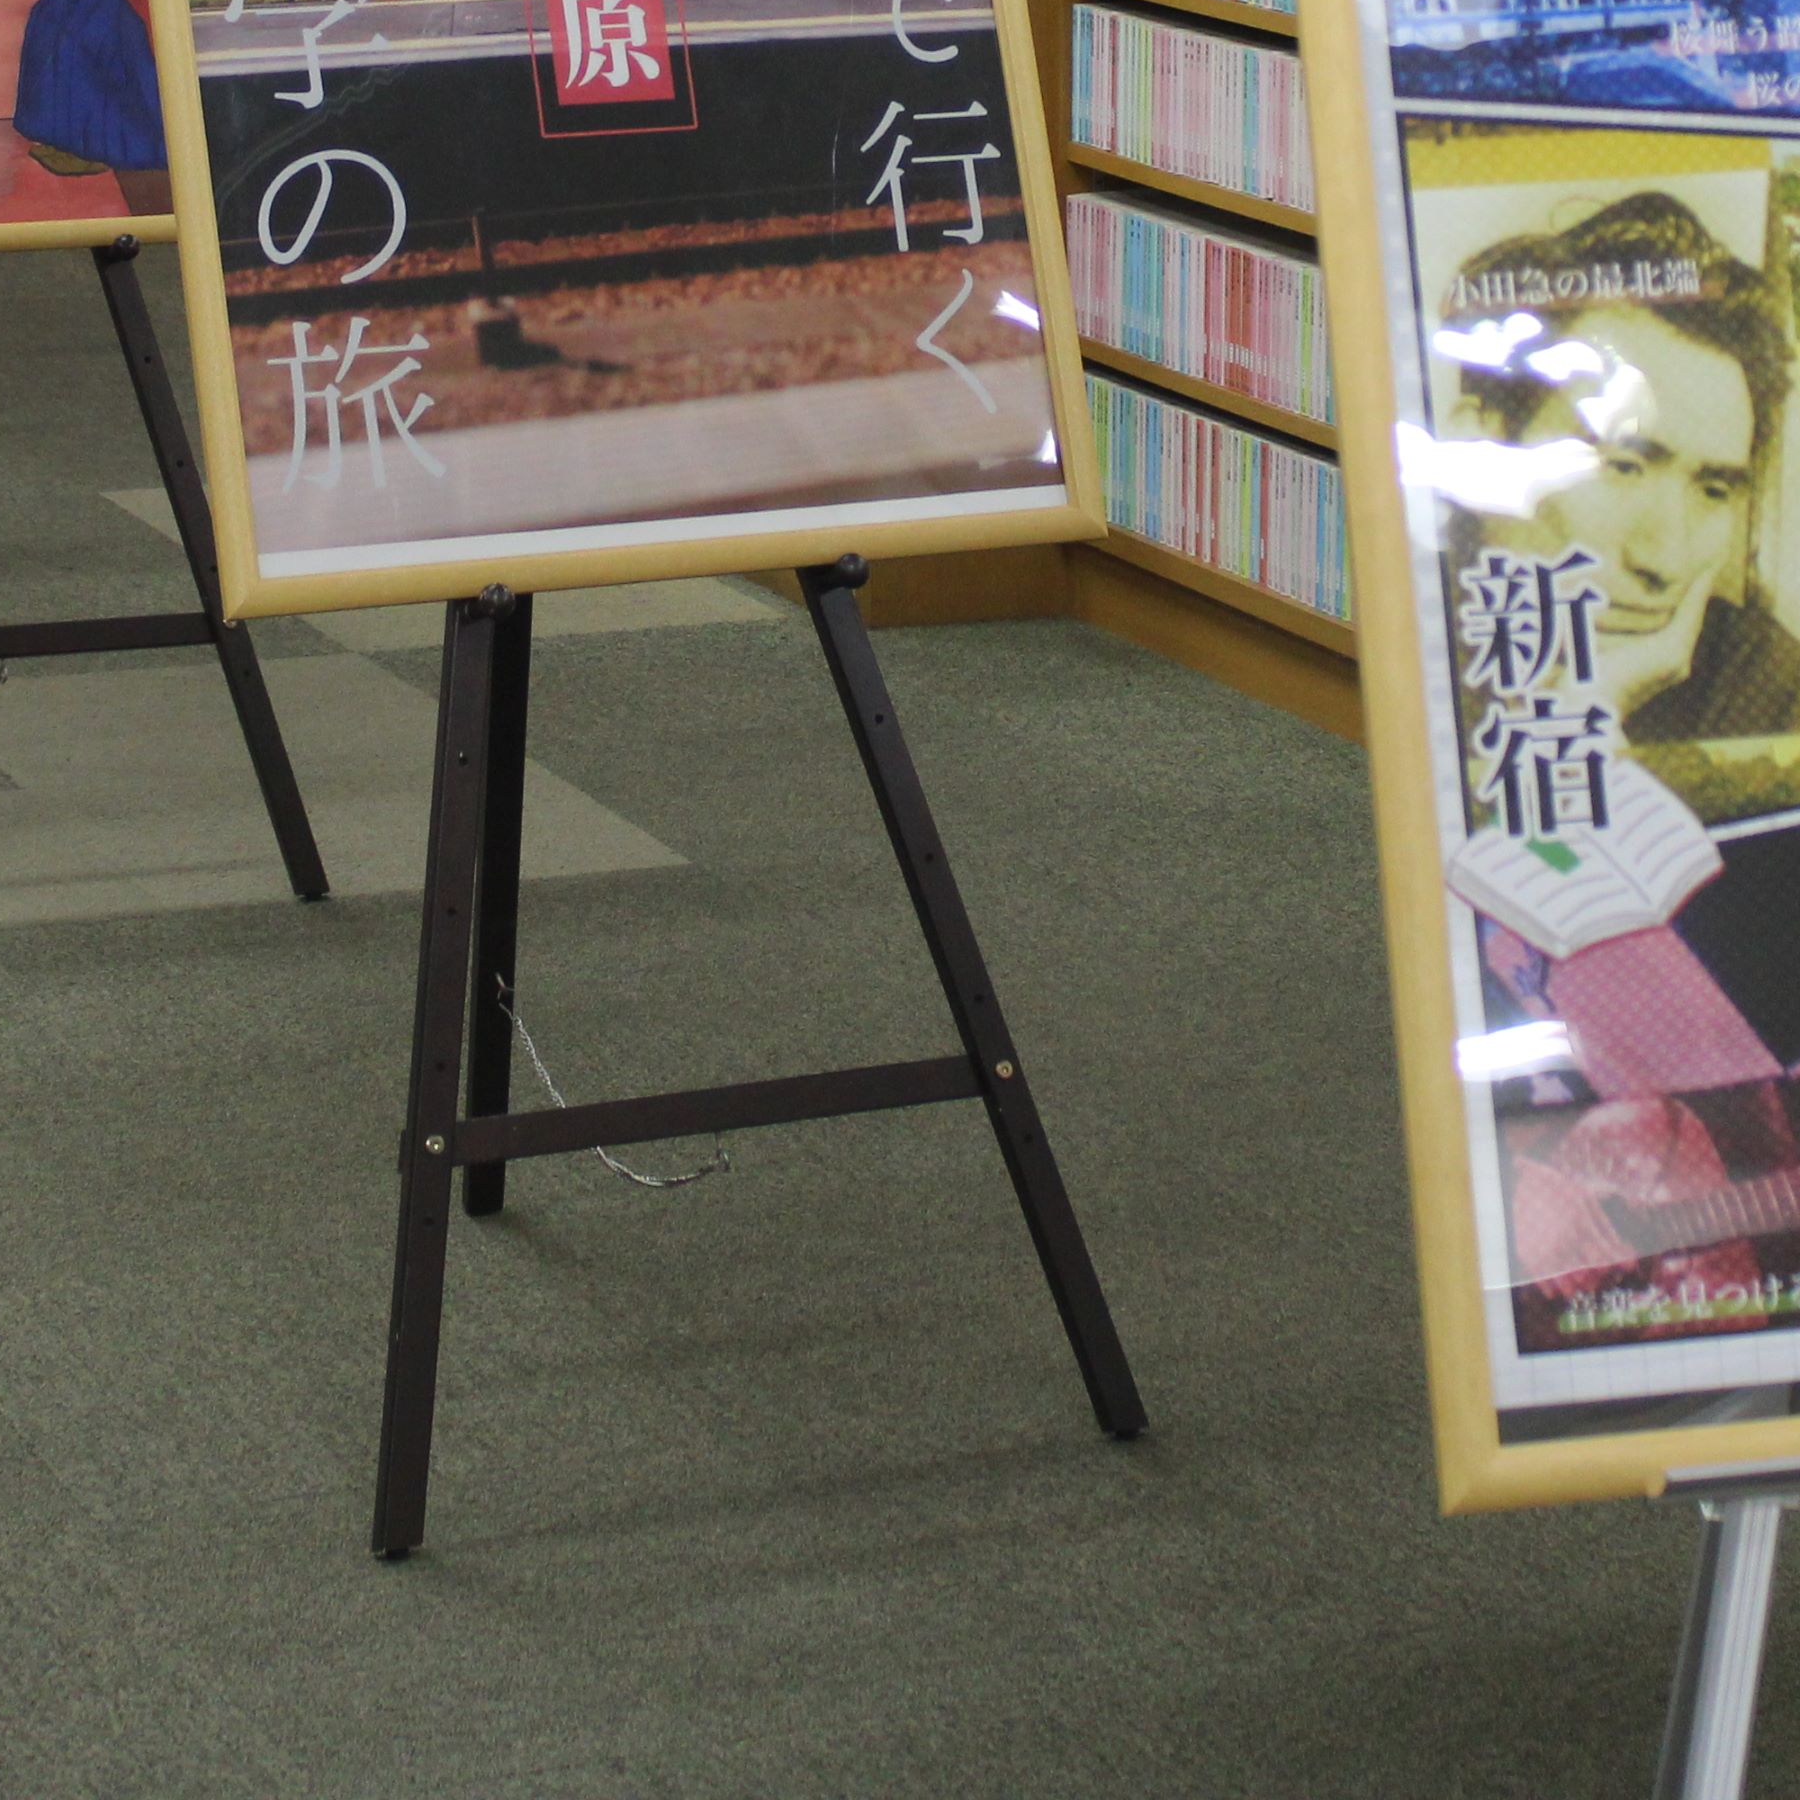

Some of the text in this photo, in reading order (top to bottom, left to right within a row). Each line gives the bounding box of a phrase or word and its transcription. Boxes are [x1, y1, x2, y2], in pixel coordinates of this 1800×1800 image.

[1450, 257, 1701, 309] 小田急の最北端
[1462, 550, 1612, 843] 新宿
